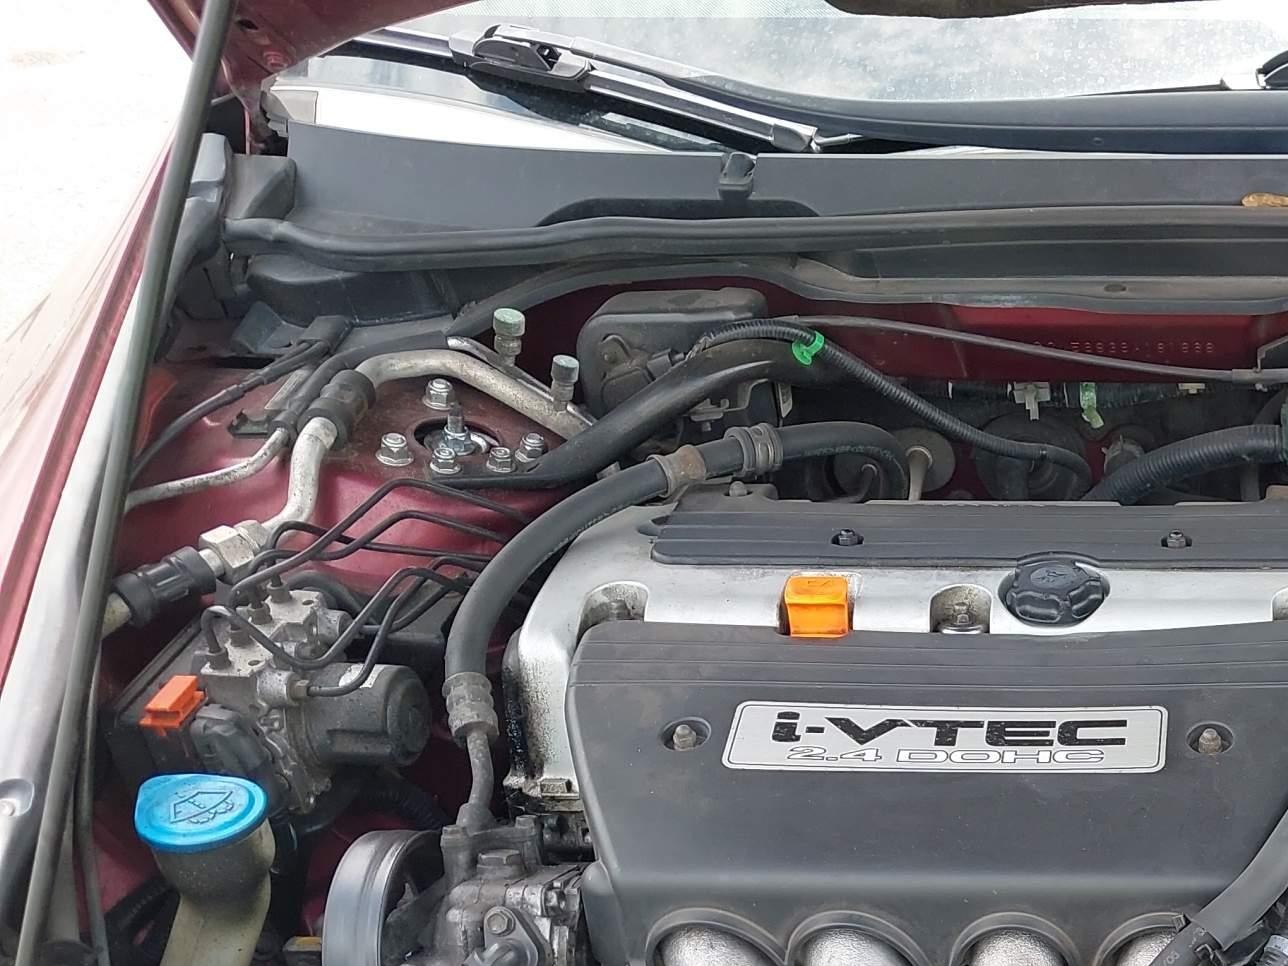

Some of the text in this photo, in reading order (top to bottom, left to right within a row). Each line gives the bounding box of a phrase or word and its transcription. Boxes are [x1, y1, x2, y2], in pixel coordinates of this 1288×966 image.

[771, 710, 1128, 747] i-VTEC
[786, 747, 1105, 764] 2.4 DOHC
